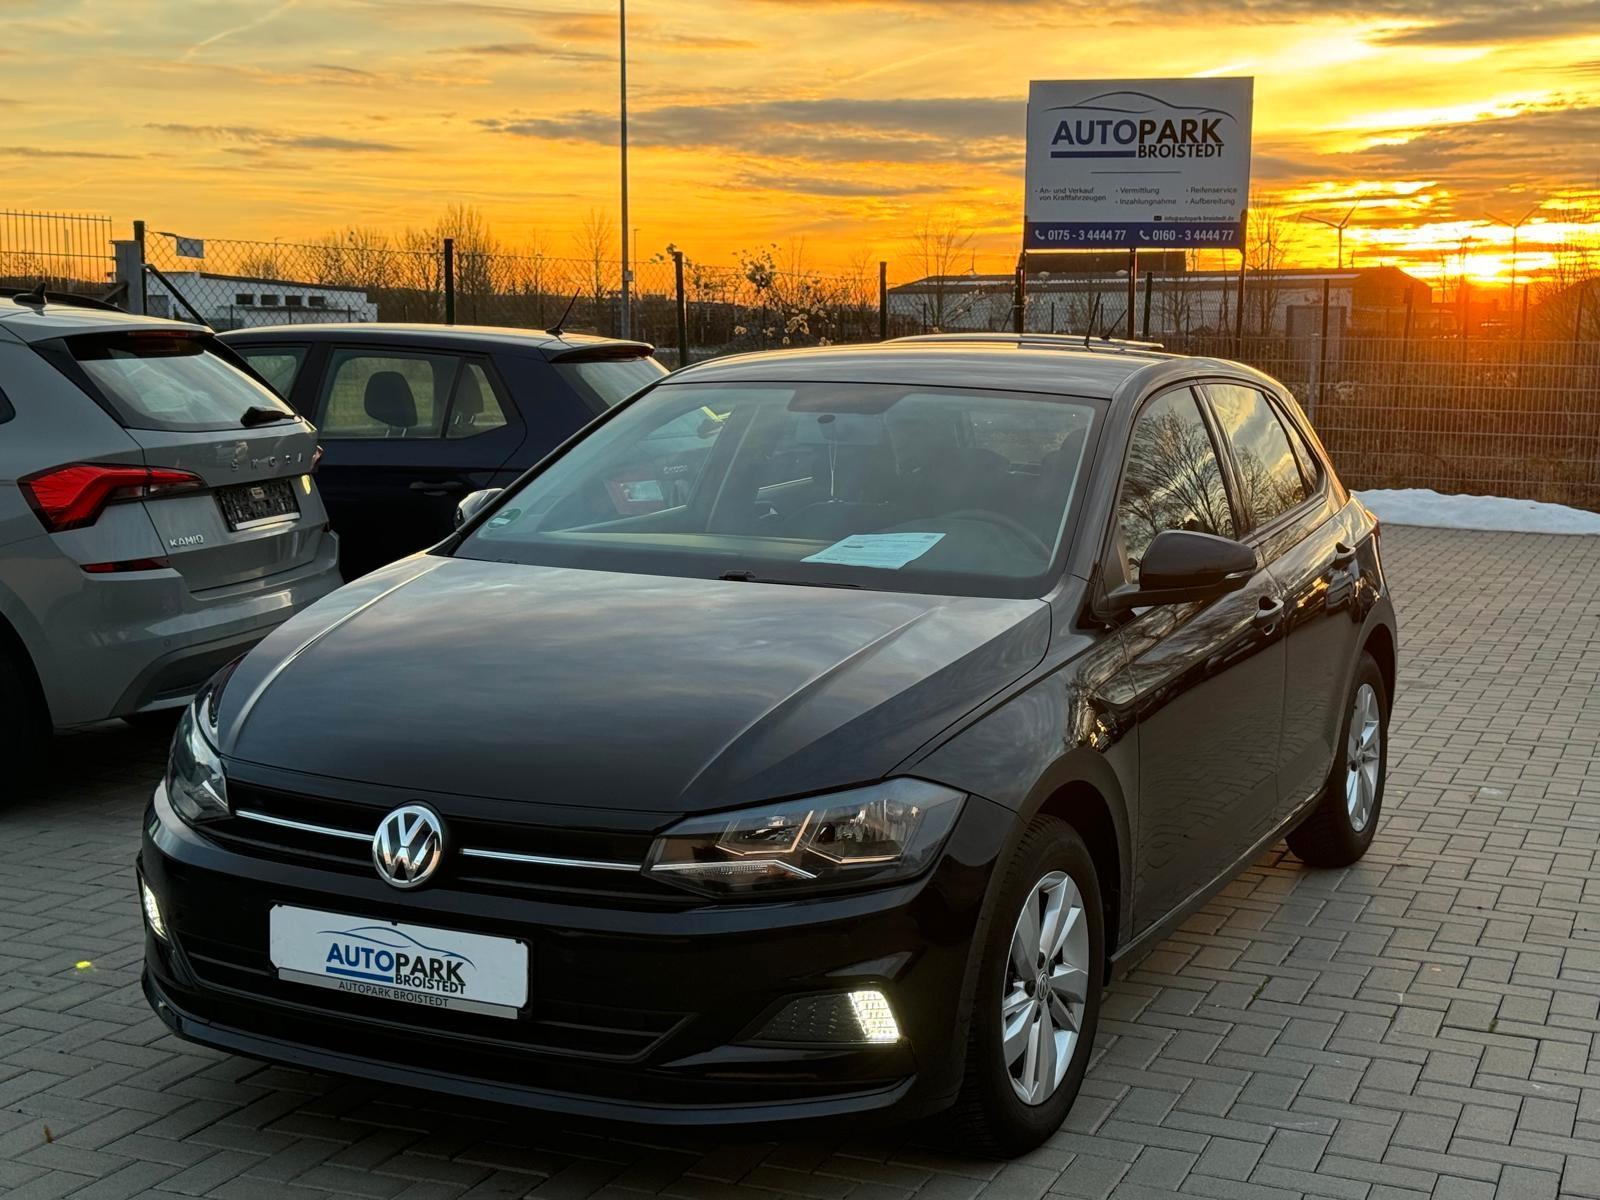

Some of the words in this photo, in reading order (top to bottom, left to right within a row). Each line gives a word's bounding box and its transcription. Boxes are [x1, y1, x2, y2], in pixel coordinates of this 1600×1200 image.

[1051, 118, 1224, 145] AUTOPARK
[1138, 143, 1224, 158] BROISTEDT
[1120, 187, 1160, 195] Vermittlung
[1190, 186, 1237, 194] Reifenservice
[1053, 194, 1106, 202] Kraftfahrzeugen
[1119, 198, 1177, 206] Inzahlungnahme
[1189, 198, 1235, 206] Aufbereitung
[1048, 229, 1070, 241] 0175
[1152, 229, 1176, 241] 0160
[169, 534, 205, 548] KAMIQ
[326, 943, 466, 984] AUTOPARK
[395, 974, 466, 995] BROISTEDT
[338, 980, 391, 999] AUTOPARK
[393, 990, 449, 1007] BROISTEDT
